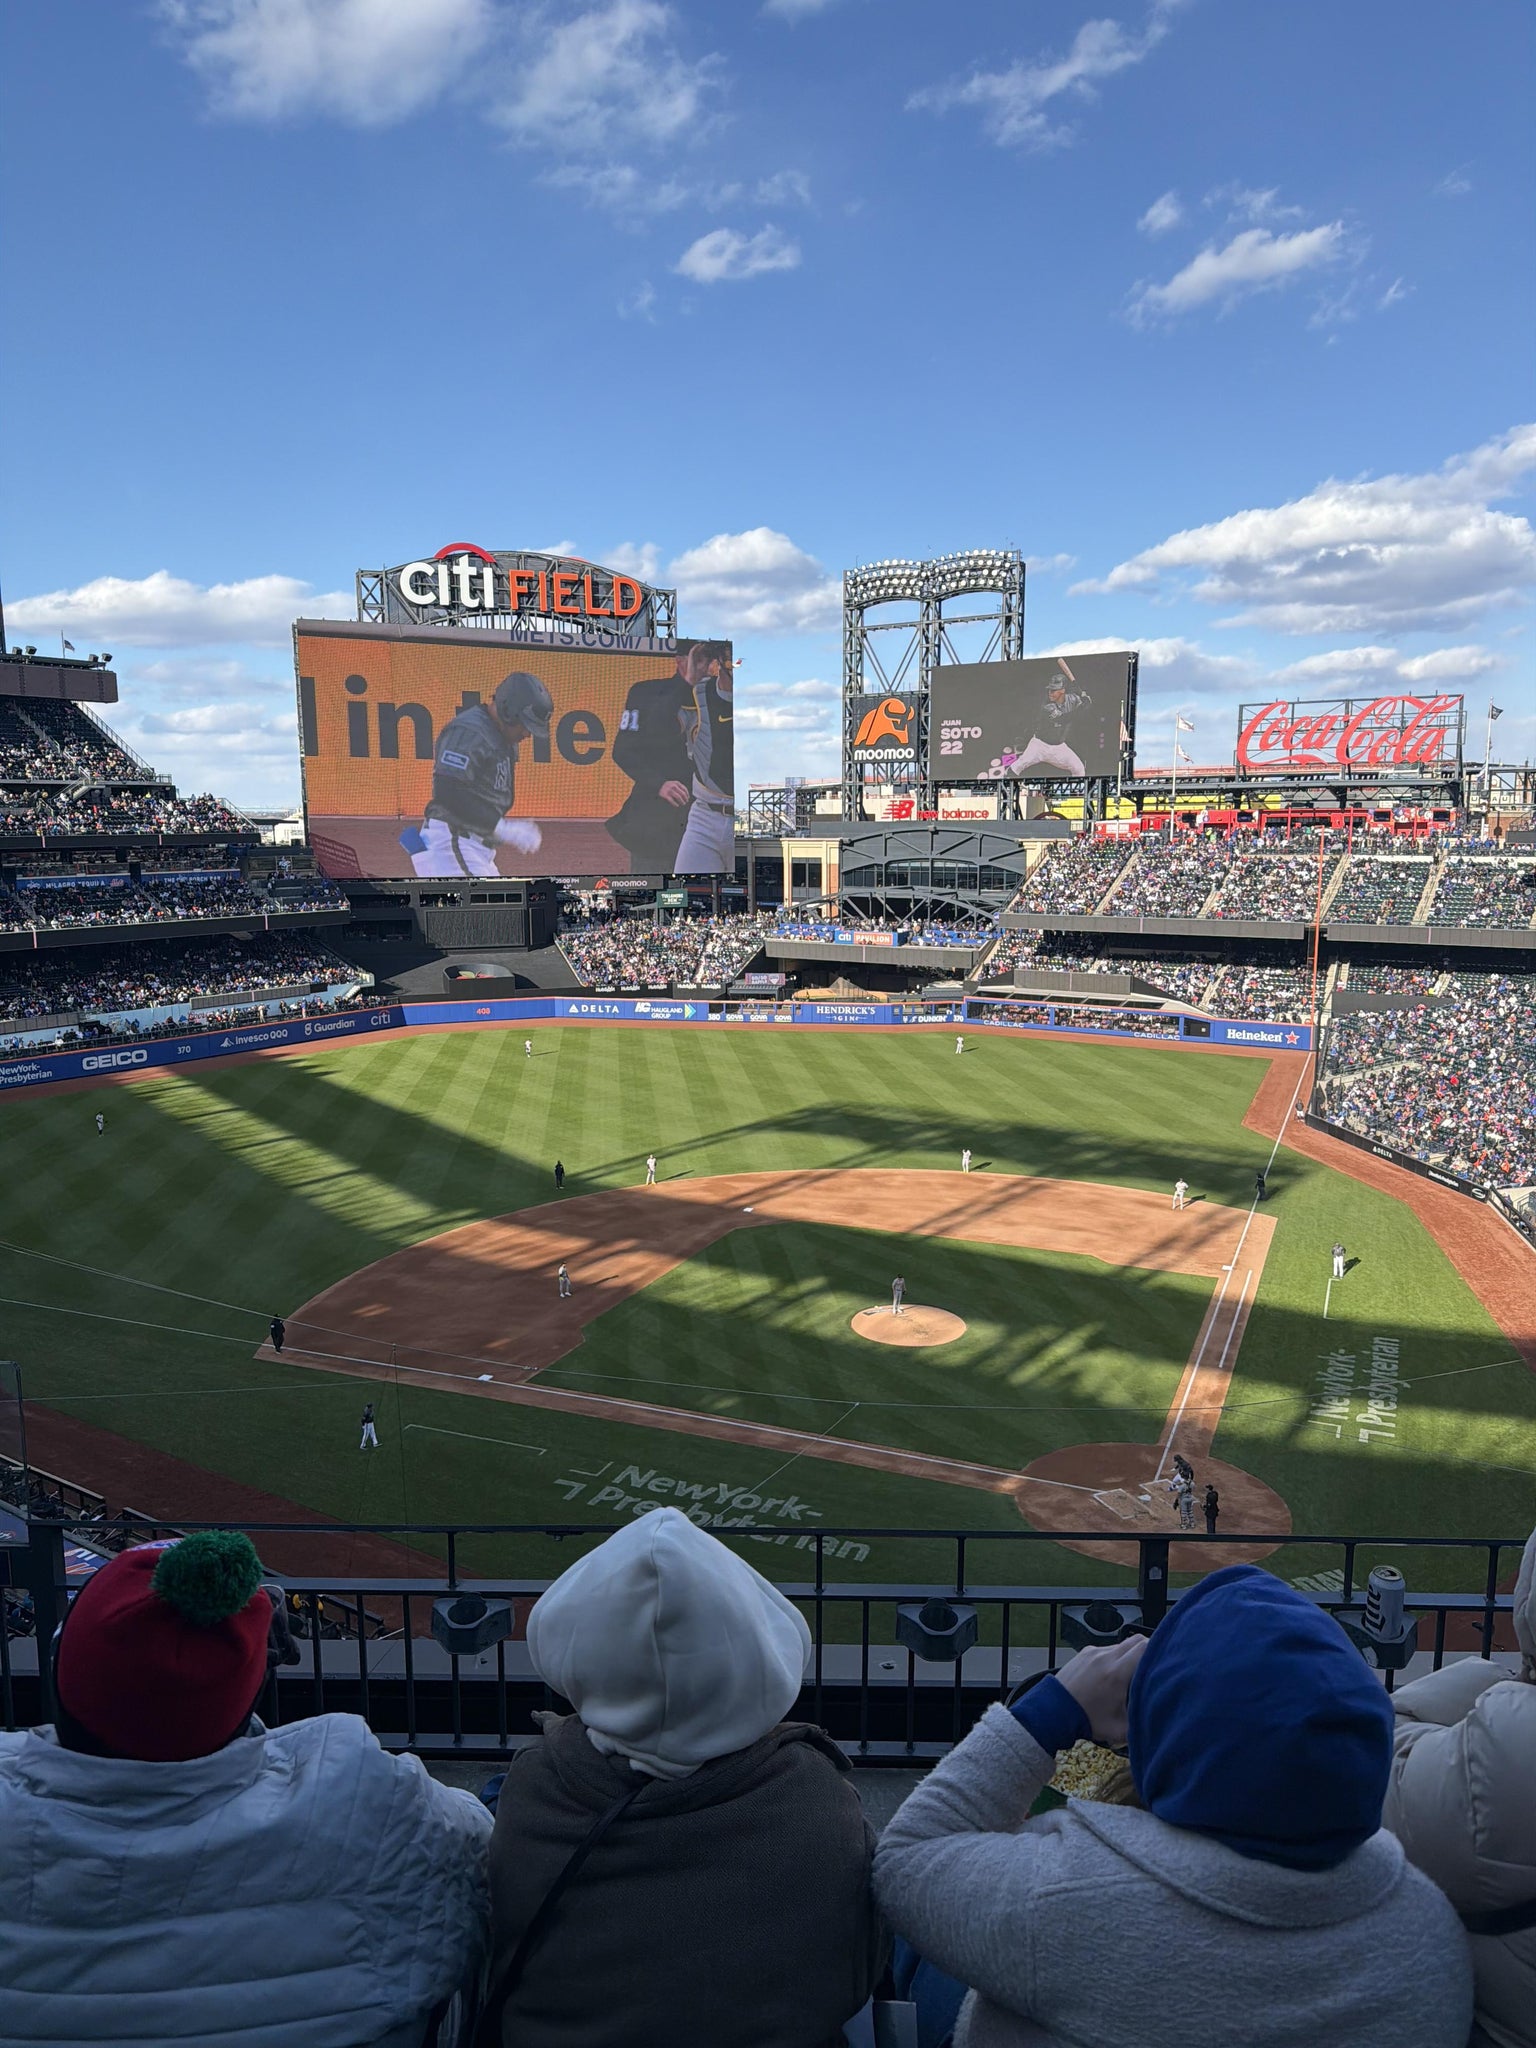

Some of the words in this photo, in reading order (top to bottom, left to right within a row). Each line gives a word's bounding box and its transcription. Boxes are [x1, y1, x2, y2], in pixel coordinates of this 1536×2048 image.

[509, 569, 643, 617] FIELD
[619, 709, 640, 732] 81
[940, 718, 962, 727] JUAN
[940, 726, 982, 740] SOTO
[854, 748, 915, 761] moomoo
[939, 741, 963, 756] 22
[941, 807, 990, 819] balance
[581, 1004, 619, 1013] DELTA
[816, 1005, 876, 1015] HENDRICK'S
[707, 1013, 720, 1021] 380
[918, 1015, 948, 1023] DUNKIN'
[983, 1019, 1025, 1028] CADILLAC
[314, 1020, 355, 1033] Guardian
[235, 1034, 269, 1045] Invesco
[269, 1028, 288, 1039] QQQ
[1133, 1031, 1181, 1041] CADILLAC
[1226, 1028, 1283, 1043] Heineken
[177, 1046, 192, 1055] 370
[82, 1049, 148, 1071] GEICO
[0, 1070, 53, 1084] Presbyterian
[1310, 1349, 1356, 1421] NewYork-
[1356, 1337, 1411, 1428] Presbyterian
[612, 1465, 824, 1521] NewYork-
